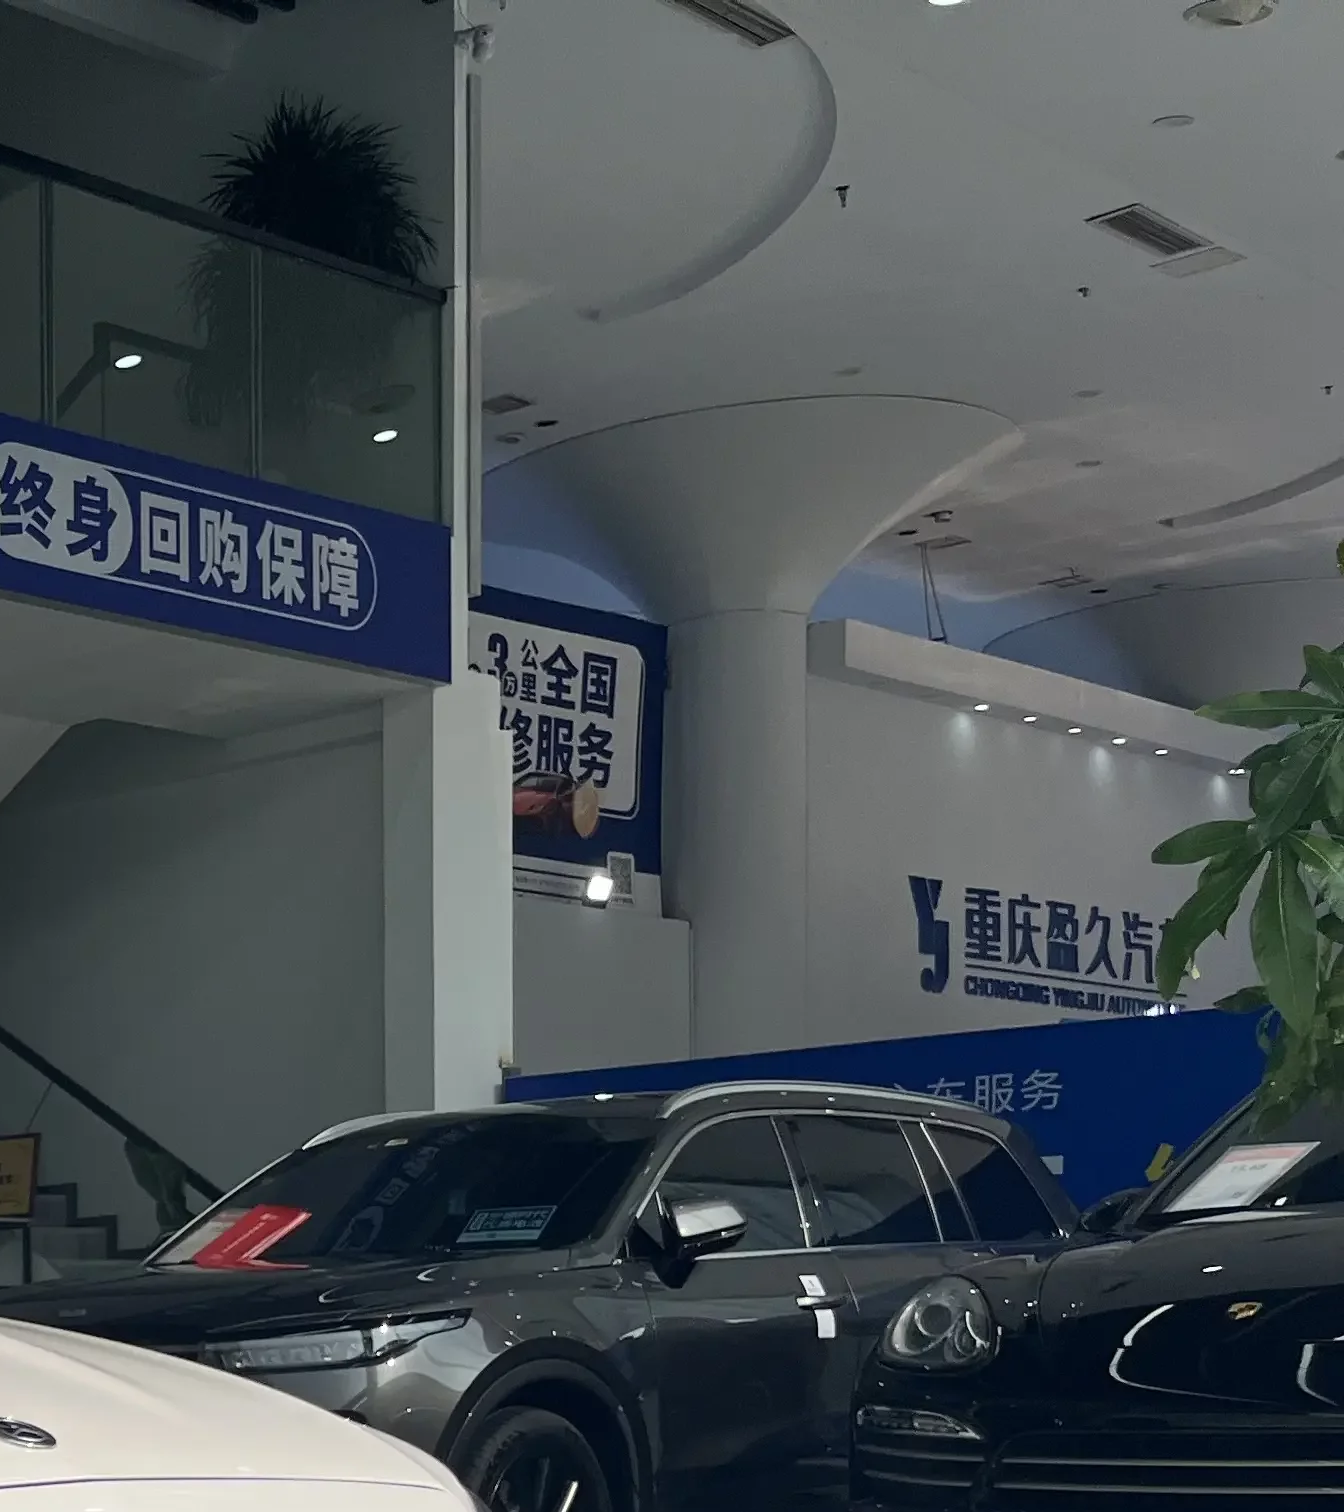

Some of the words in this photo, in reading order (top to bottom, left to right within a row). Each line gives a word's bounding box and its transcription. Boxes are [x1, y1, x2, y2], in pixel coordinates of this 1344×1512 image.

[964, 886, 1174, 985] 重庆盈久汽
